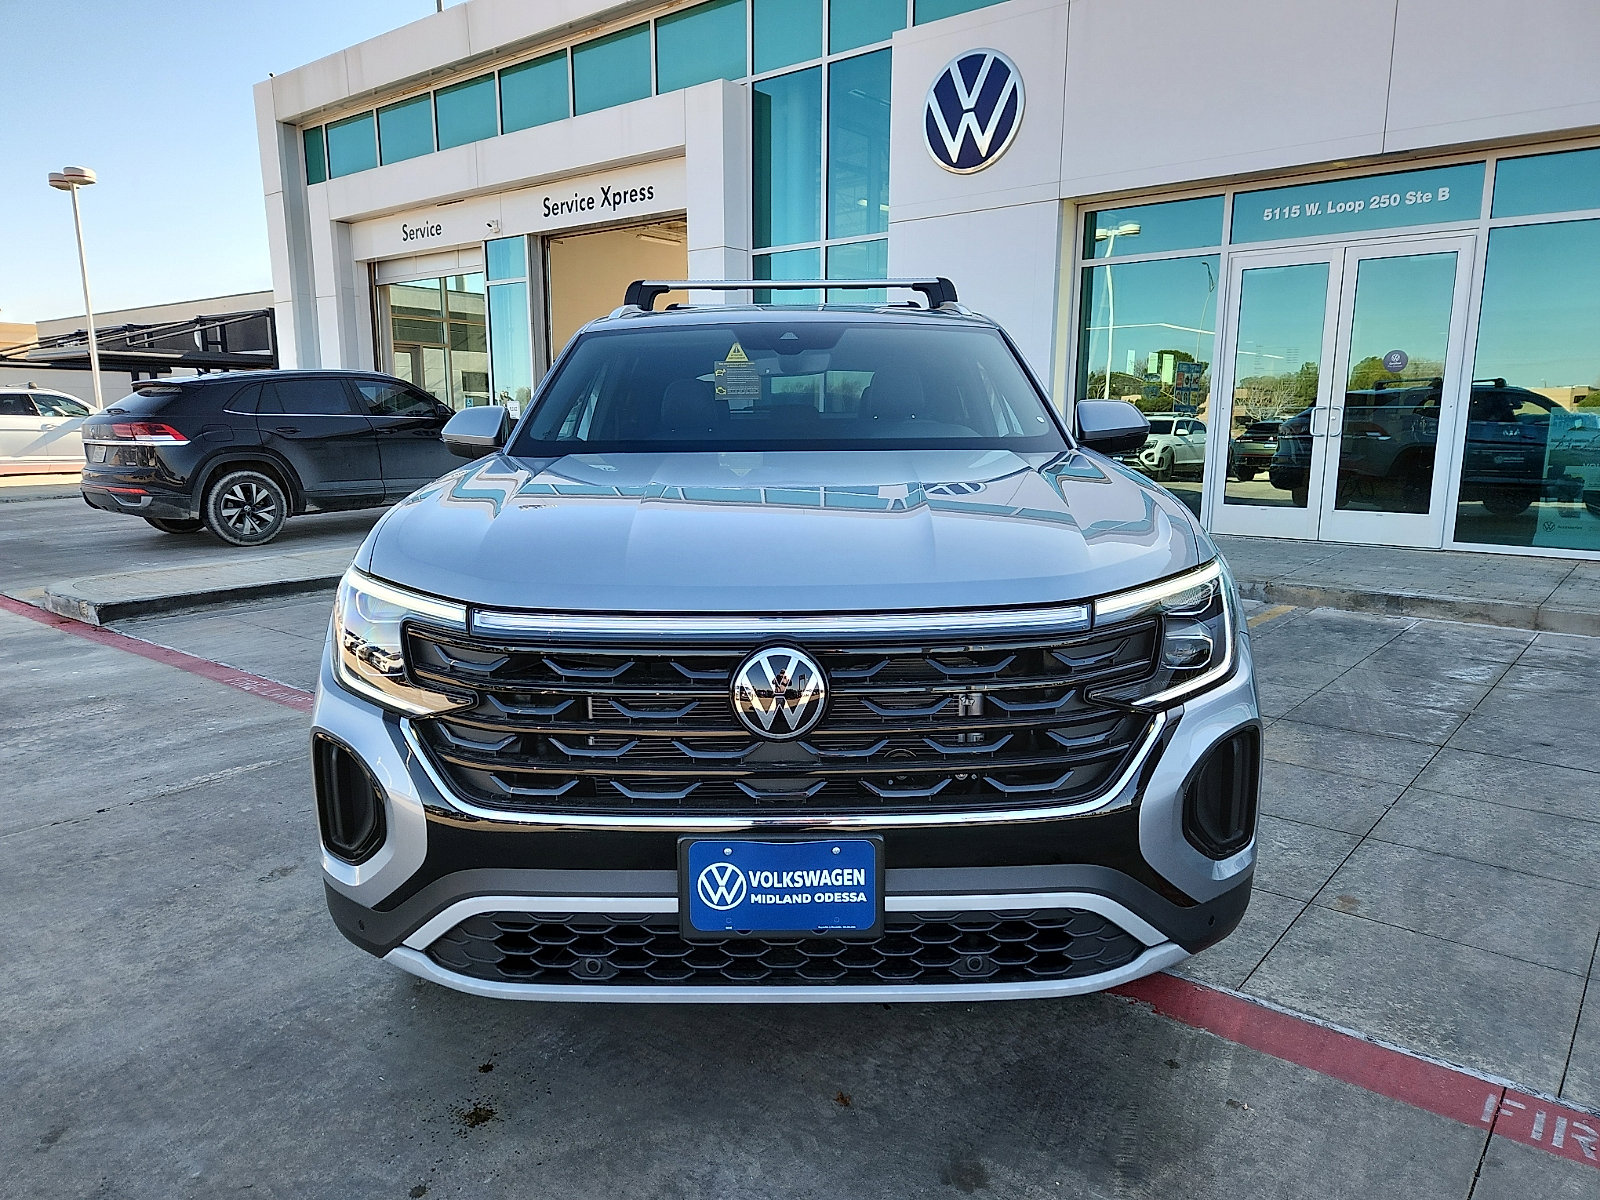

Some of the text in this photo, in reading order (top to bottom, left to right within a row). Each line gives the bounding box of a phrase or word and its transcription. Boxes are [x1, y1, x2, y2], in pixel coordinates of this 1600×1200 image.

[543, 186, 654, 217] Service Xpress
[1263, 187, 1450, 221] 5115 W. Loop 250 Ste B
[402, 220, 442, 241] Service
[749, 868, 865, 888] VOLKSWAGEN
[750, 892, 867, 904] MIDLAND ODESSA
